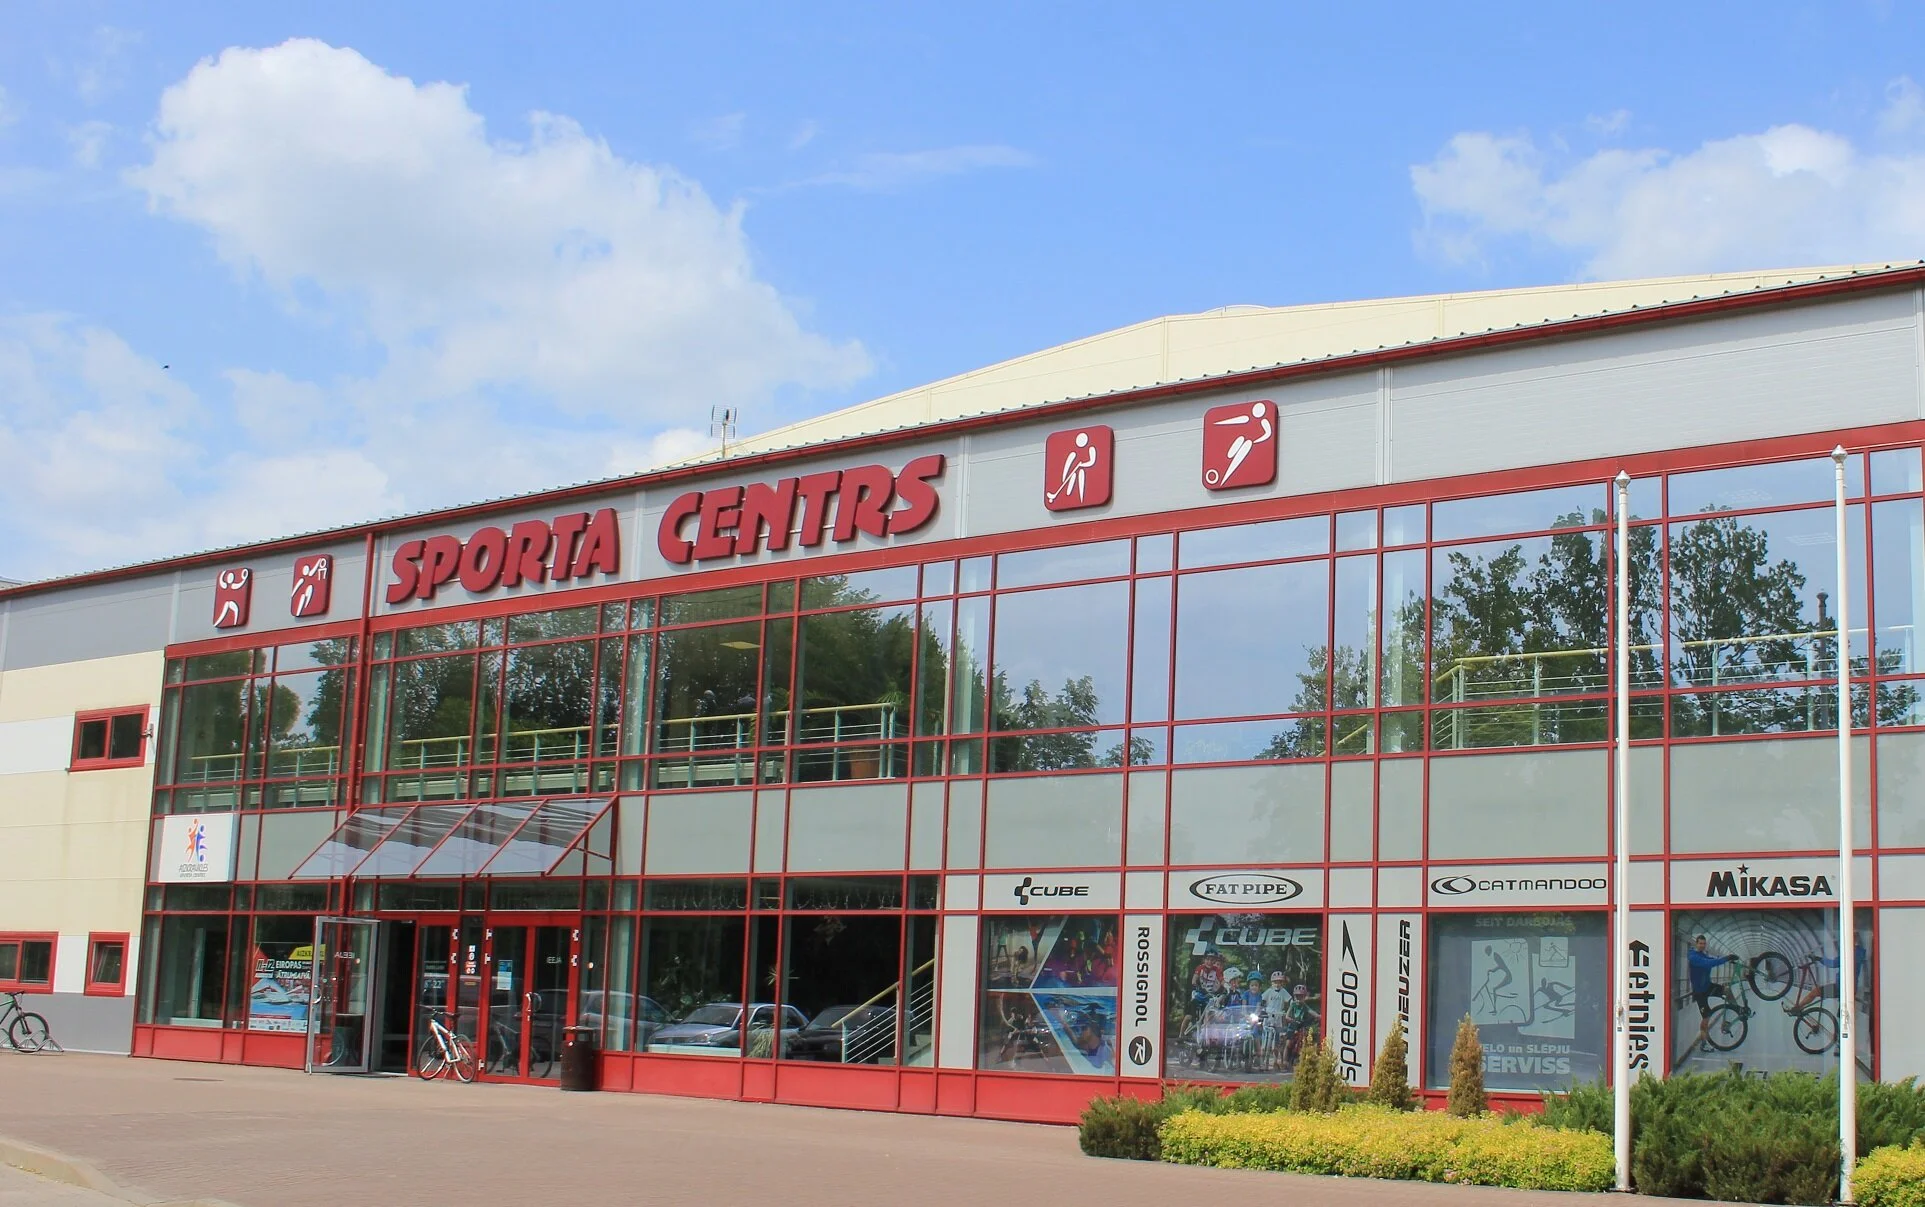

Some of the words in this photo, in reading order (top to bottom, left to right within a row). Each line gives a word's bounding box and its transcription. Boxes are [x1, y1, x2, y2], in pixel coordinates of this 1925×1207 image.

[386, 508, 620, 604] SPORTA
[658, 454, 945, 564] CENTRS
[1030, 885, 1089, 897] CUBE
[1205, 883, 1240, 896] FAT
[1242, 882, 1288, 896] PIPE
[1478, 877, 1607, 891] CATMANDOO
[1215, 928, 1318, 946] CUBE
[275, 960, 303, 969] EIROPAS
[1135, 926, 1150, 1027] ROSSIGNOL
[1336, 971, 1362, 1082] speedo
[1629, 971, 1655, 1070] etnies
[1481, 1043, 1505, 1053] ELO
[1508, 1045, 1522, 1053] un
